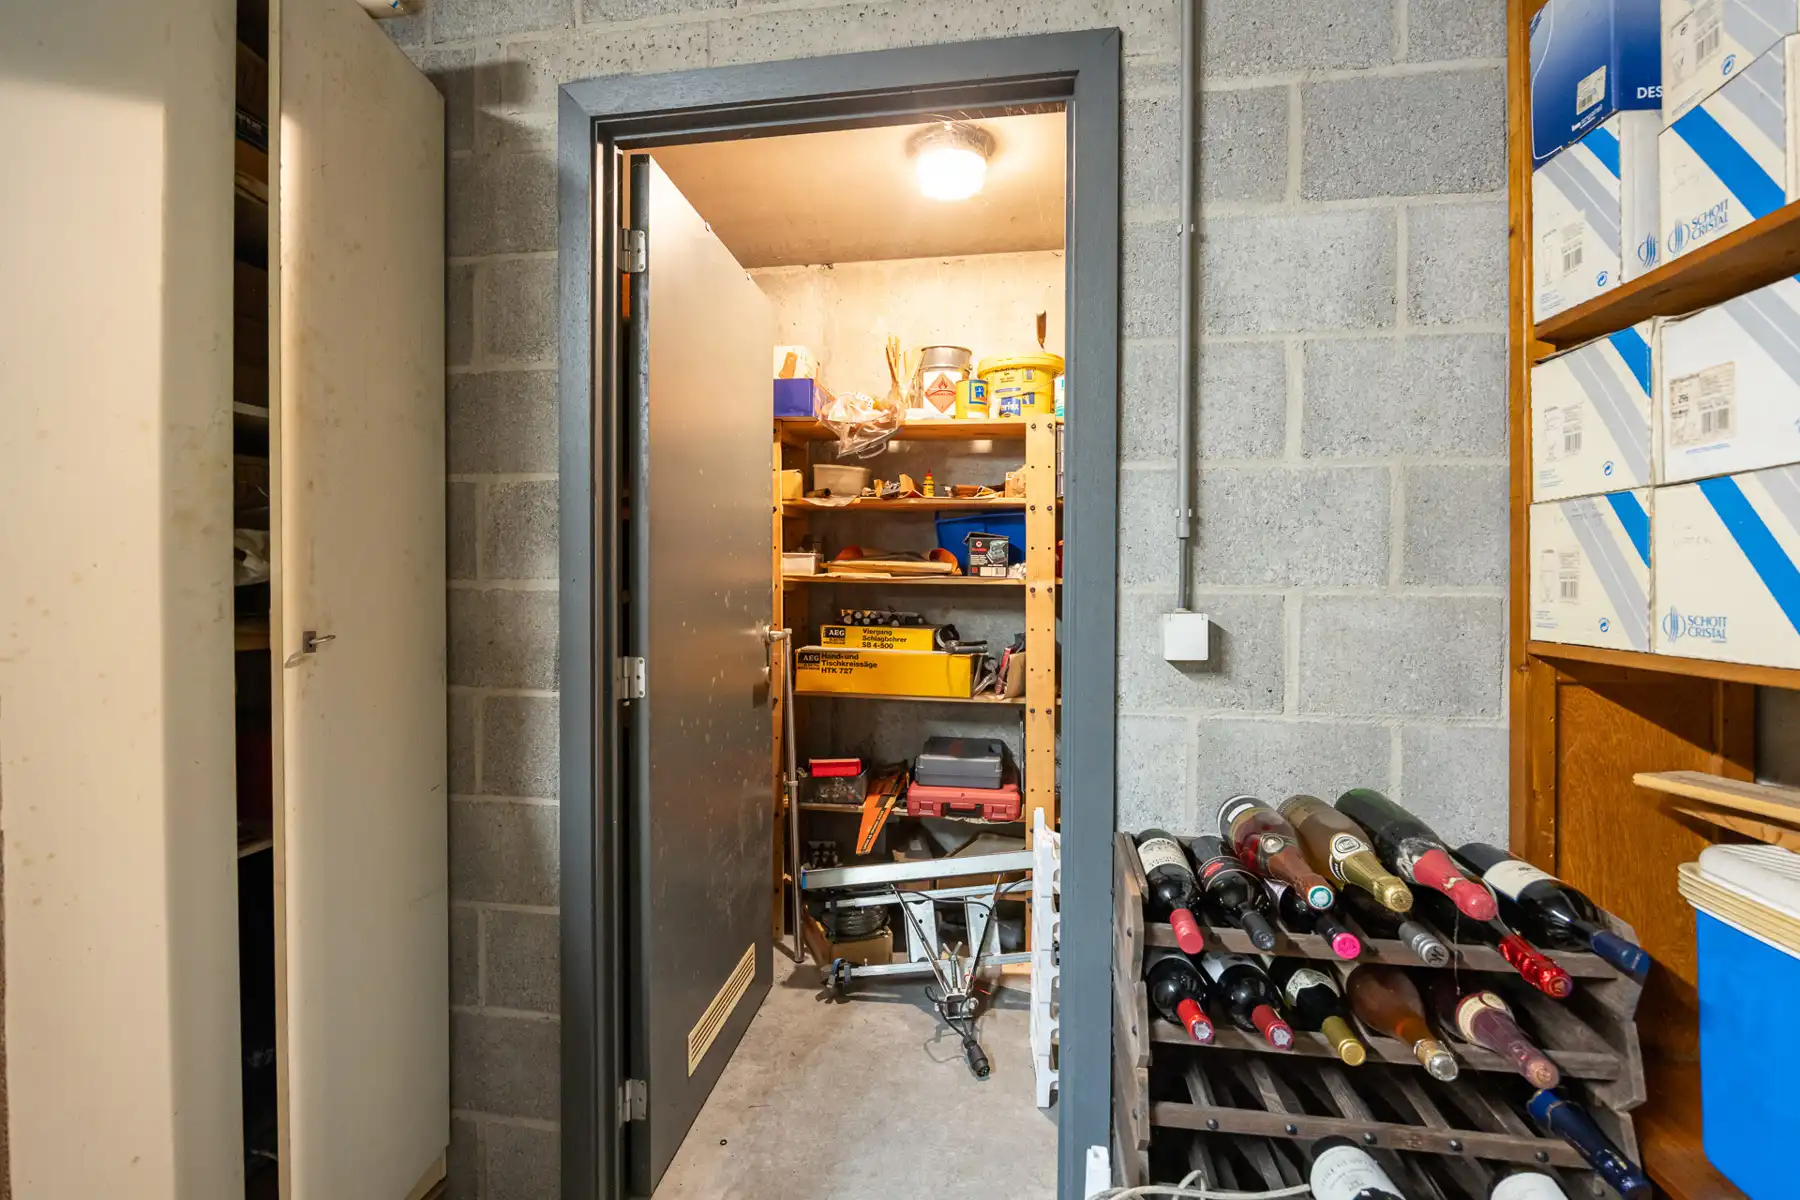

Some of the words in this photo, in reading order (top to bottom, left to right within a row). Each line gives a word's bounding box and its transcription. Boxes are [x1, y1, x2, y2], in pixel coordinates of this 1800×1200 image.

[1636, 86, 1662, 99] DES
[1691, 198, 1728, 229] SCHOTT
[1691, 211, 1728, 240] CRISTAL
[1687, 615, 1727, 628] SCHOTT
[828, 629, 845, 637] AEG
[862, 628, 892, 636] Viergang
[1687, 626, 1727, 640] CRISTAL
[862, 635, 907, 643] Schlagbohrer
[821, 652, 844, 660] Hand-
[821, 660, 877, 669] Tischkreissäge
